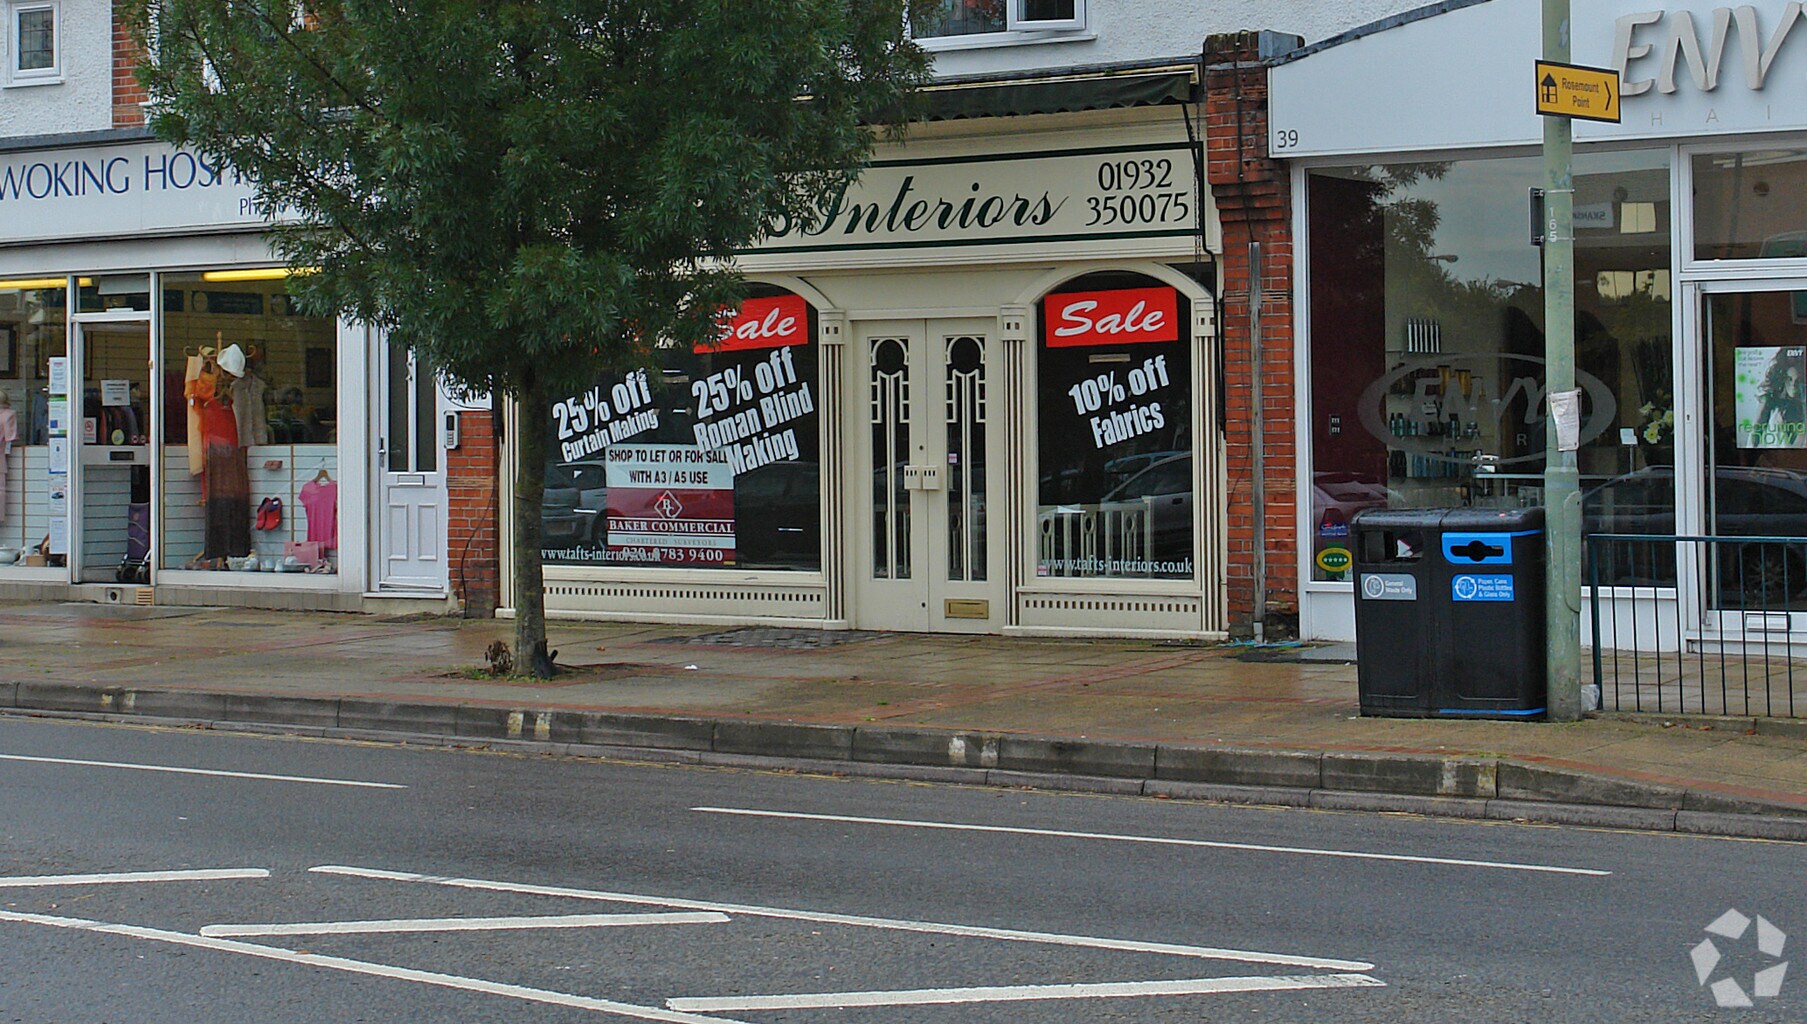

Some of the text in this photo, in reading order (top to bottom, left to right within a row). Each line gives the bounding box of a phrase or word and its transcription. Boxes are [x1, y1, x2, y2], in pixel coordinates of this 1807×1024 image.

[1611, 2, 1807, 97] ENV
[1561, 77, 1600, 93] Rosemount
[1572, 95, 1591, 108] Point
[1277, 129, 1299, 148] 39
[0, 150, 266, 200] WOKING HOSP
[1097, 158, 1173, 192] 01932
[801, 173, 1069, 235] Interiors
[1084, 191, 1190, 227] 350075
[1054, 300, 1166, 337] Sale
[691, 345, 798, 419] 25% off
[1068, 354, 1170, 415] 10% off
[552, 386, 611, 441] 25%
[611, 367, 652, 416] off
[693, 381, 814, 454] Roman Blind
[561, 408, 659, 463] Curtain Making
[1090, 402, 1166, 449] Fabrics
[1738, 421, 1806, 434] recruiting
[1751, 432, 1794, 445] now
[609, 449, 633, 462] SHOP
[635, 449, 647, 462] TO
[650, 450, 666, 463] LET
[669, 450, 682, 463] OR
[685, 450, 703, 463] FOR
[725, 428, 800, 477] Making
[629, 470, 652, 483] WITH
[654, 470, 667, 483] A3
[674, 471, 687, 484] A5
[689, 471, 708, 484] USE
[609, 519, 735, 533] BAKER COMMERCIAL
[626, 537, 717, 546] CHARTERED SURVEYORS
[689, 548, 723, 561] 9400
[1042, 555, 1193, 573] www.tafts-interiors.co.uk
[1401, 586, 1413, 594] Only
